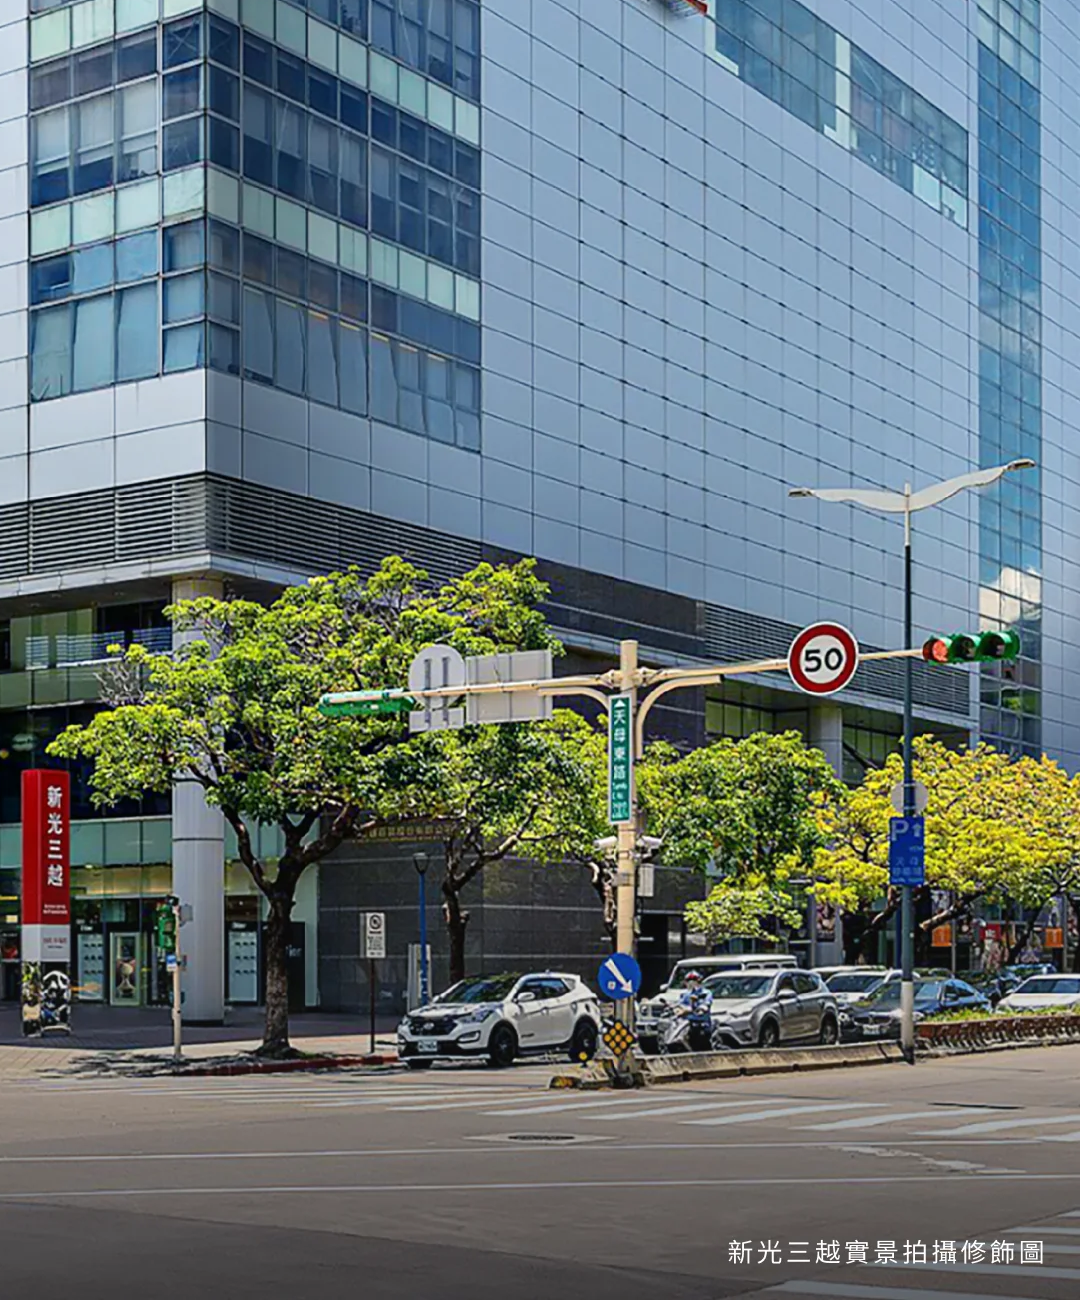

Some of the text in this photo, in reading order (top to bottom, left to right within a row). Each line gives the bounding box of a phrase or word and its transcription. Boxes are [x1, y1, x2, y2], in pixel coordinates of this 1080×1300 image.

[804, 647, 843, 672] 50
[613, 708, 627, 780] 天母東路
[47, 785, 64, 888] 新光三越
[891, 820, 910, 842] P
